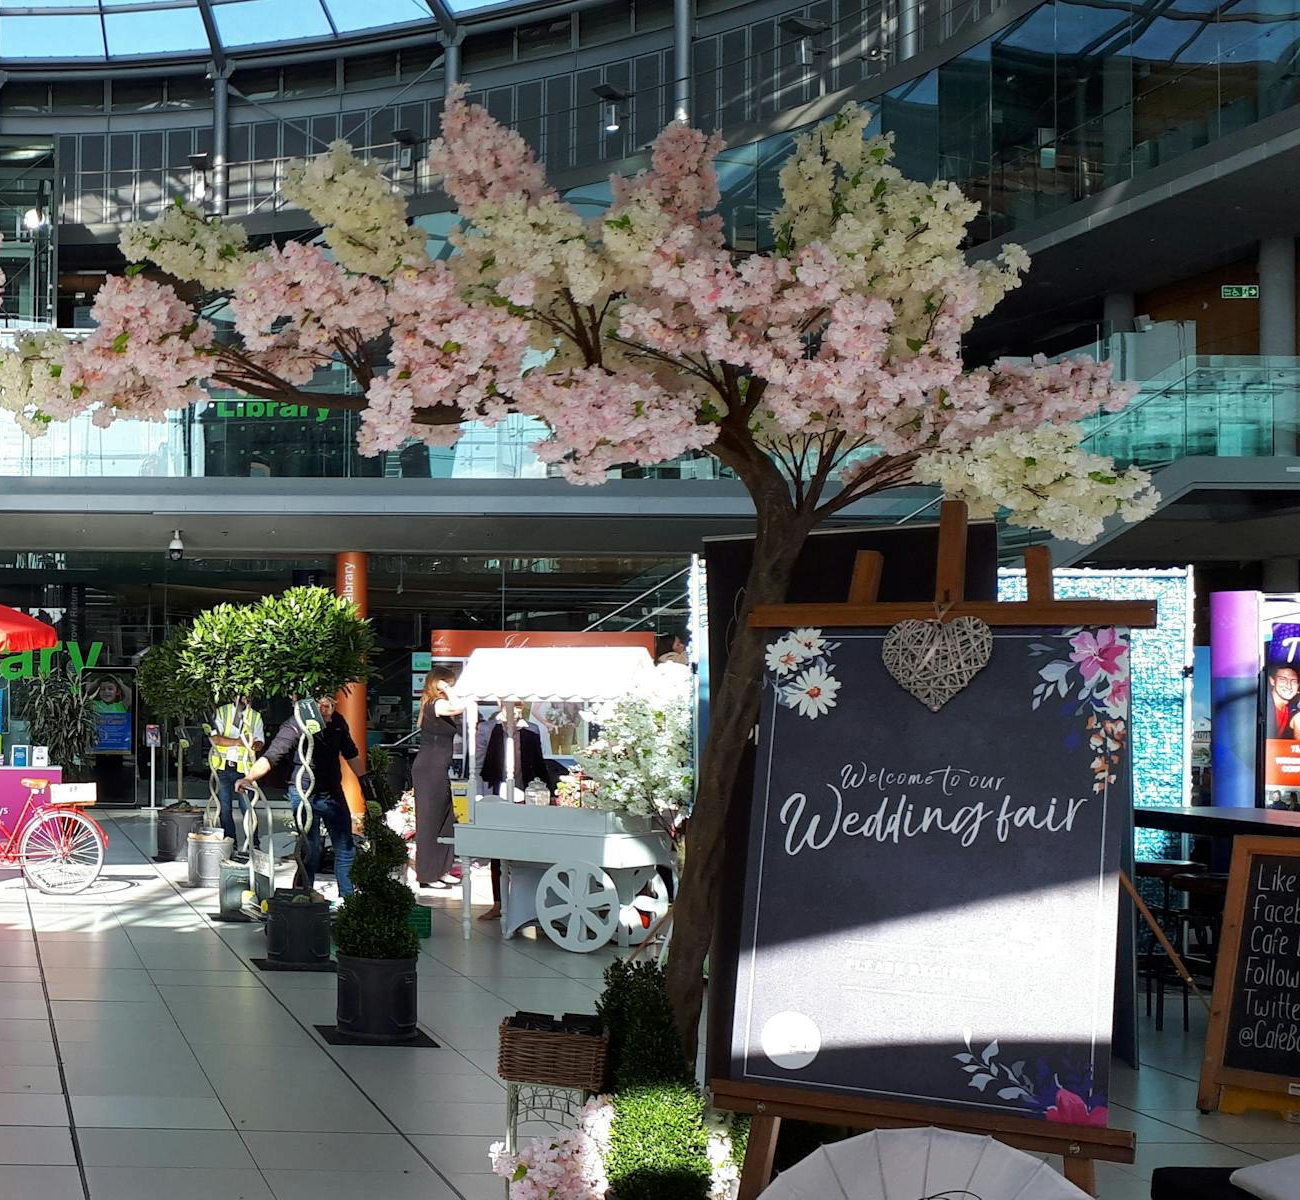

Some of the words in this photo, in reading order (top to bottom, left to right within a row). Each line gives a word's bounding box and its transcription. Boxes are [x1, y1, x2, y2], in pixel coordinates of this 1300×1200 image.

[840, 761, 934, 791] Welcome
[931, 765, 970, 795] to
[969, 774, 1006, 791] our
[779, 783, 994, 856] Wedding
[995, 795, 1089, 842] fair
[1257, 863, 1297, 892] Like
[1250, 925, 1289, 955] Cafe
[1244, 956, 1300, 988] Follow
[1243, 988, 1300, 1021] Twitte
